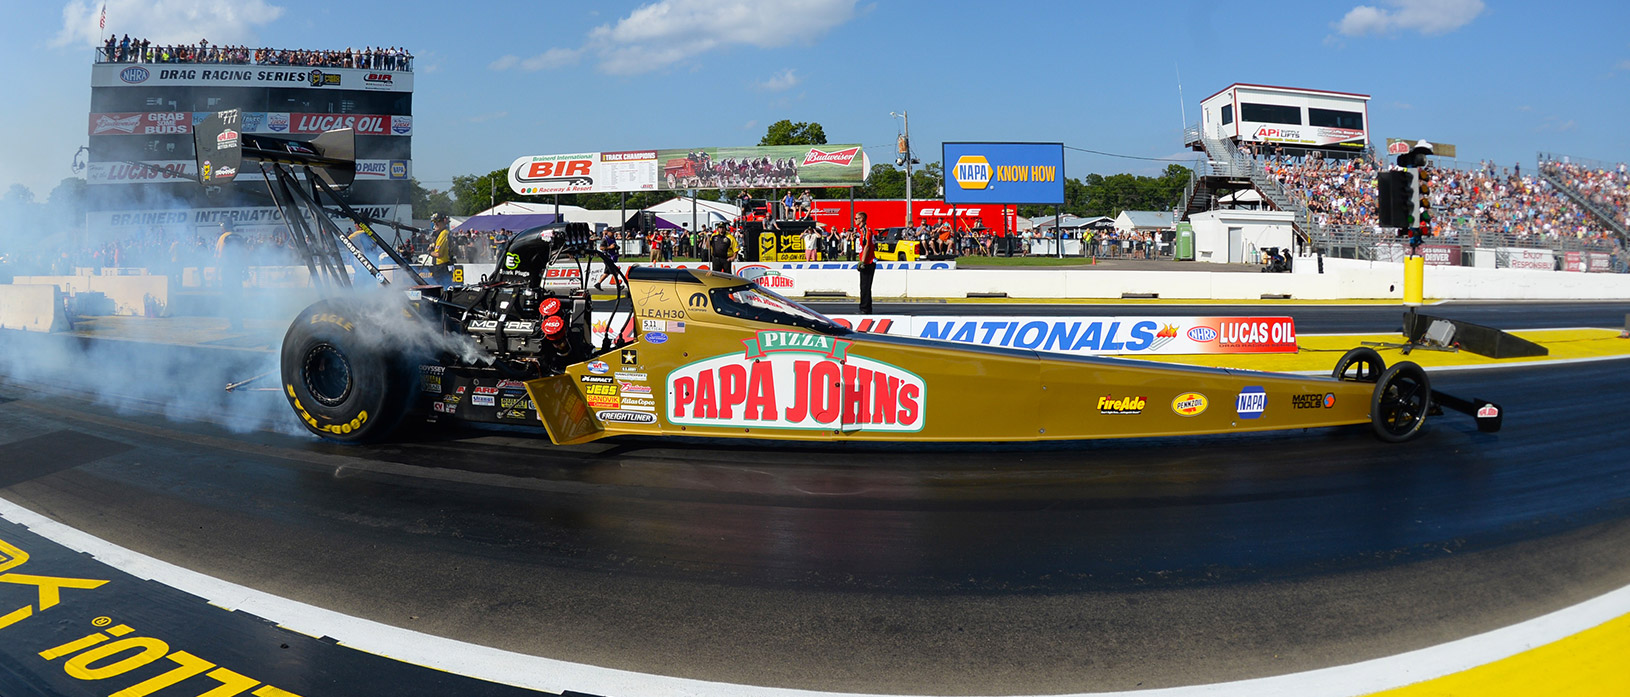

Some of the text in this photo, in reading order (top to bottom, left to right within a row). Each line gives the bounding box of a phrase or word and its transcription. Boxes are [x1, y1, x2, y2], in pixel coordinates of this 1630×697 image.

[121, 69, 148, 82] NHRA
[160, 69, 196, 80] DRAG
[201, 70, 252, 81] RACING
[257, 71, 306, 82] SERIES
[368, 73, 393, 81] BIR
[148, 113, 184, 121] GRAB
[145, 125, 187, 134] BUDS
[298, 115, 384, 132] LUCAS OIL
[623, 152, 656, 160] CHAMPIONS
[804, 151, 854, 162] Budweiser
[107, 163, 160, 180] LUCAS
[162, 163, 187, 180] OIL
[362, 163, 386, 173] PARTS
[392, 166, 405, 174] NAPA
[528, 160, 593, 178] BIR
[959, 164, 1056, 182] NAPA KNOW HOW
[111, 211, 188, 226] BRAINERD
[919, 208, 981, 217] ELITE
[340, 234, 373, 271] GOODYEAR
[547, 269, 580, 277] BIR
[543, 301, 557, 311] MSD
[641, 308, 685, 319] LEAH30
[311, 312, 354, 332] EAGLE
[472, 320, 532, 329] MOAR
[919, 320, 1158, 351] NATIONALS
[1190, 327, 1217, 341] NHRA
[1220, 322, 1295, 343] LUCAS OIL
[764, 332, 829, 348] PIZZA
[474, 386, 499, 395] ARP
[586, 384, 618, 396] JEGS
[674, 360, 920, 426] PAPA JOHN'S
[587, 395, 619, 403] SANDVIK
[621, 397, 655, 406] Atlas Copco
[1096, 394, 1146, 411] FireAde
[1176, 398, 1204, 410] PENNZOIL
[1239, 394, 1266, 411] NAPA
[1292, 394, 1323, 402] MATCO
[286, 384, 368, 435] GOODYEAR
[1292, 401, 1322, 409] TOOLS
[601, 412, 651, 421] FREIGHTLINER
